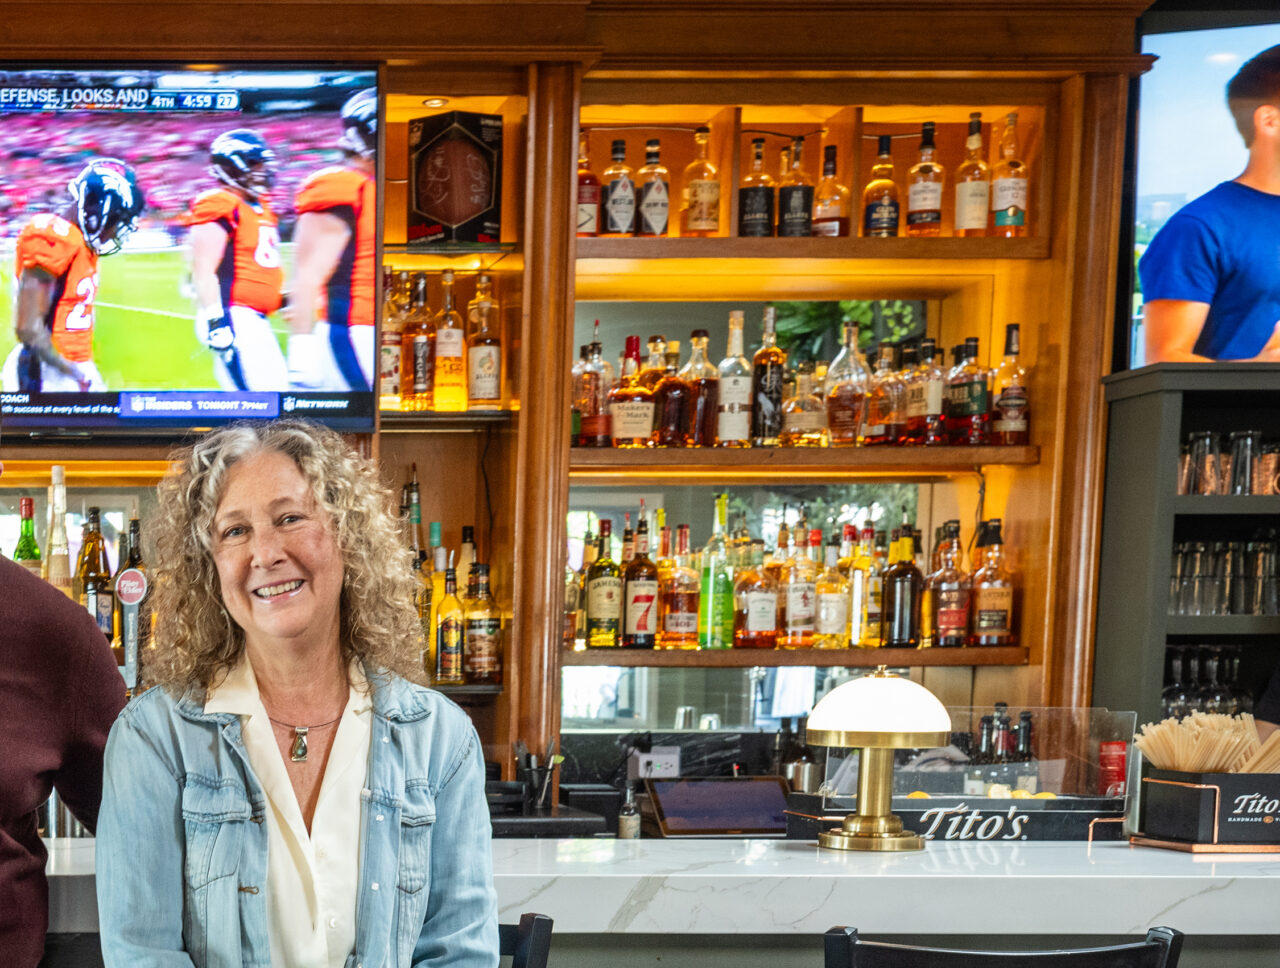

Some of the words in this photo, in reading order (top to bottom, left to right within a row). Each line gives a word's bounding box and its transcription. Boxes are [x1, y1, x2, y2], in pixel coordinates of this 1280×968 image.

[63, 88, 114, 103] LOOKS
[116, 88, 149, 103] AND
[151, 95, 175, 108] 4TH
[183, 95, 212, 108] 4:59
[197, 401, 239, 410] TONIGHT
[296, 399, 349, 408] NETWORK
[632, 595, 656, 631] 7
[1232, 792, 1280, 815] Tito
